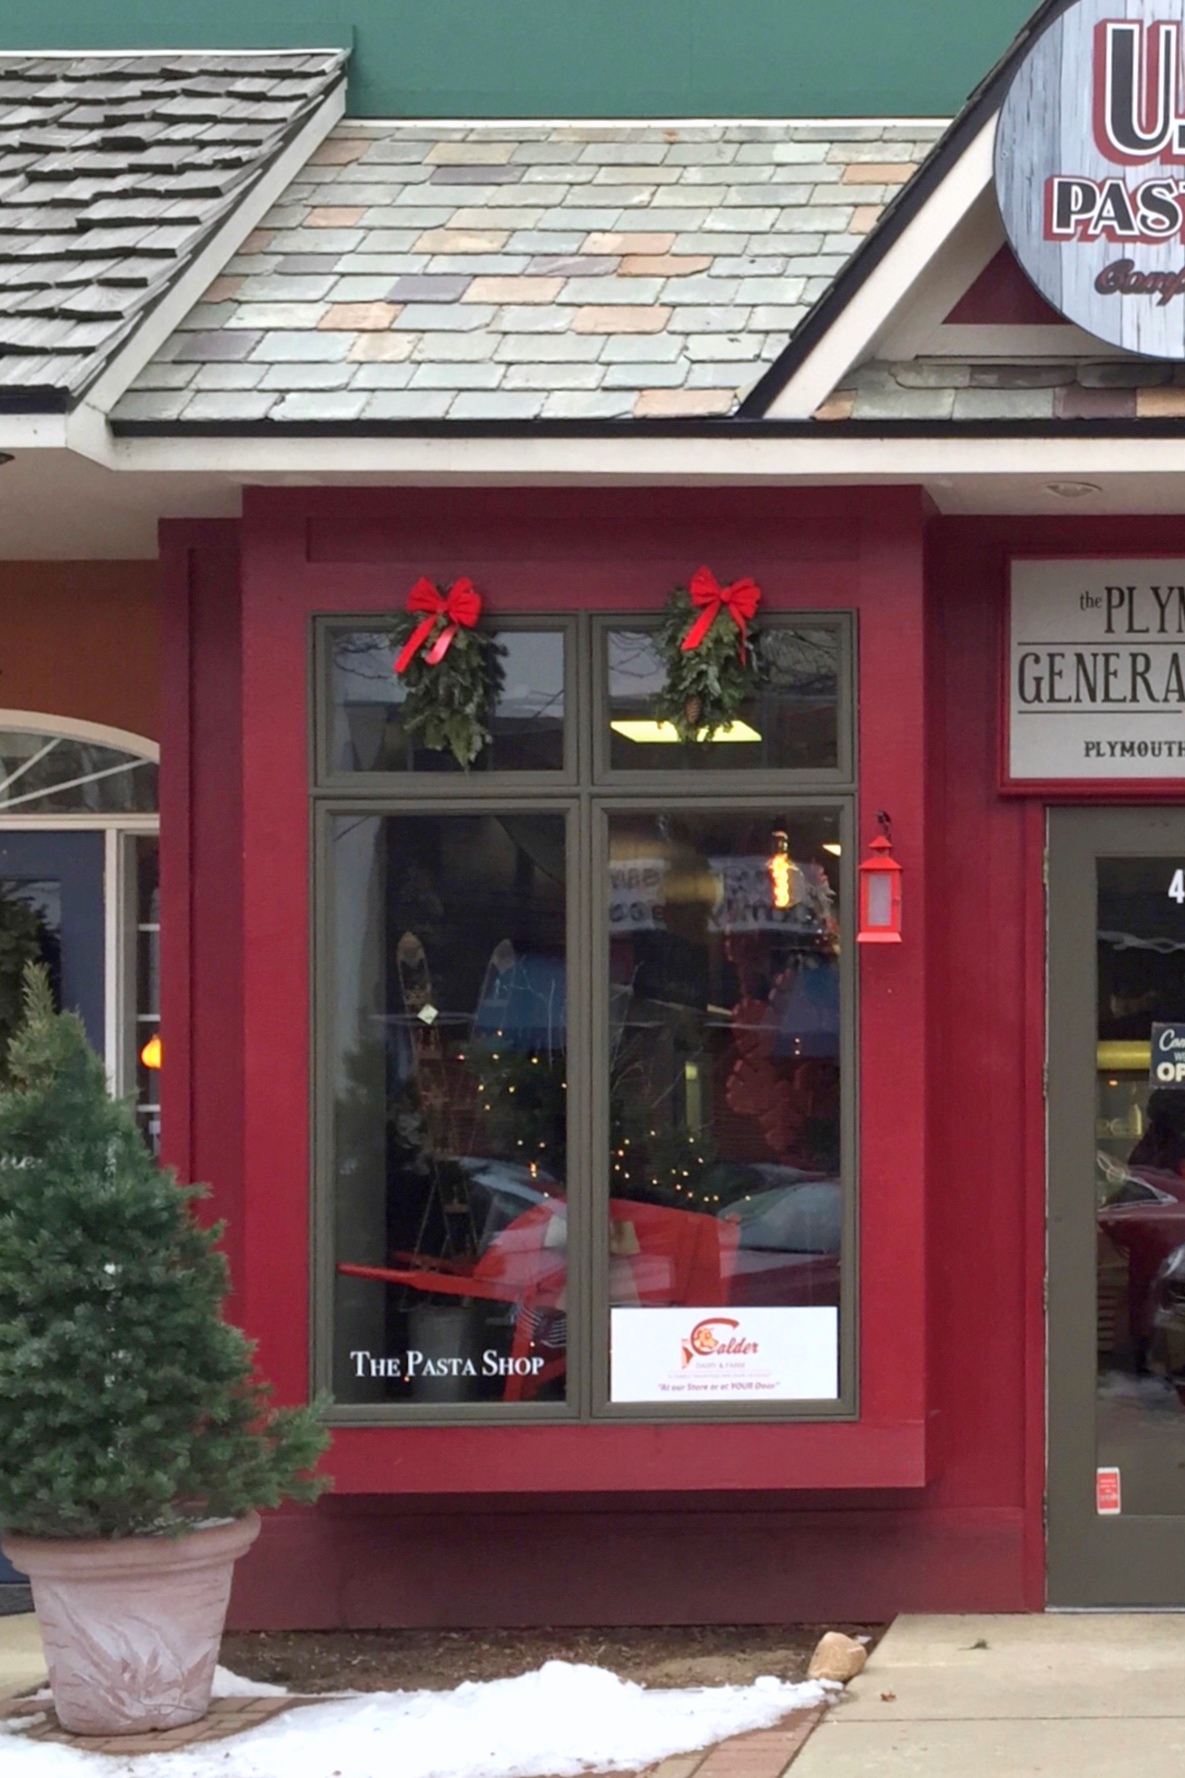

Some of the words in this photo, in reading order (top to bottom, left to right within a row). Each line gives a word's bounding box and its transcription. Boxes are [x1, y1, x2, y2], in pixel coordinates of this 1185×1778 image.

[1080, 591, 1102, 611] the
[690, 1317, 759, 1356] Calder
[350, 1351, 401, 1377] THE
[406, 1350, 477, 1377] PASTA
[482, 1350, 545, 1376] SHOP
[687, 1383, 708, 1391] Store
[731, 1382, 753, 1390] YOUR
